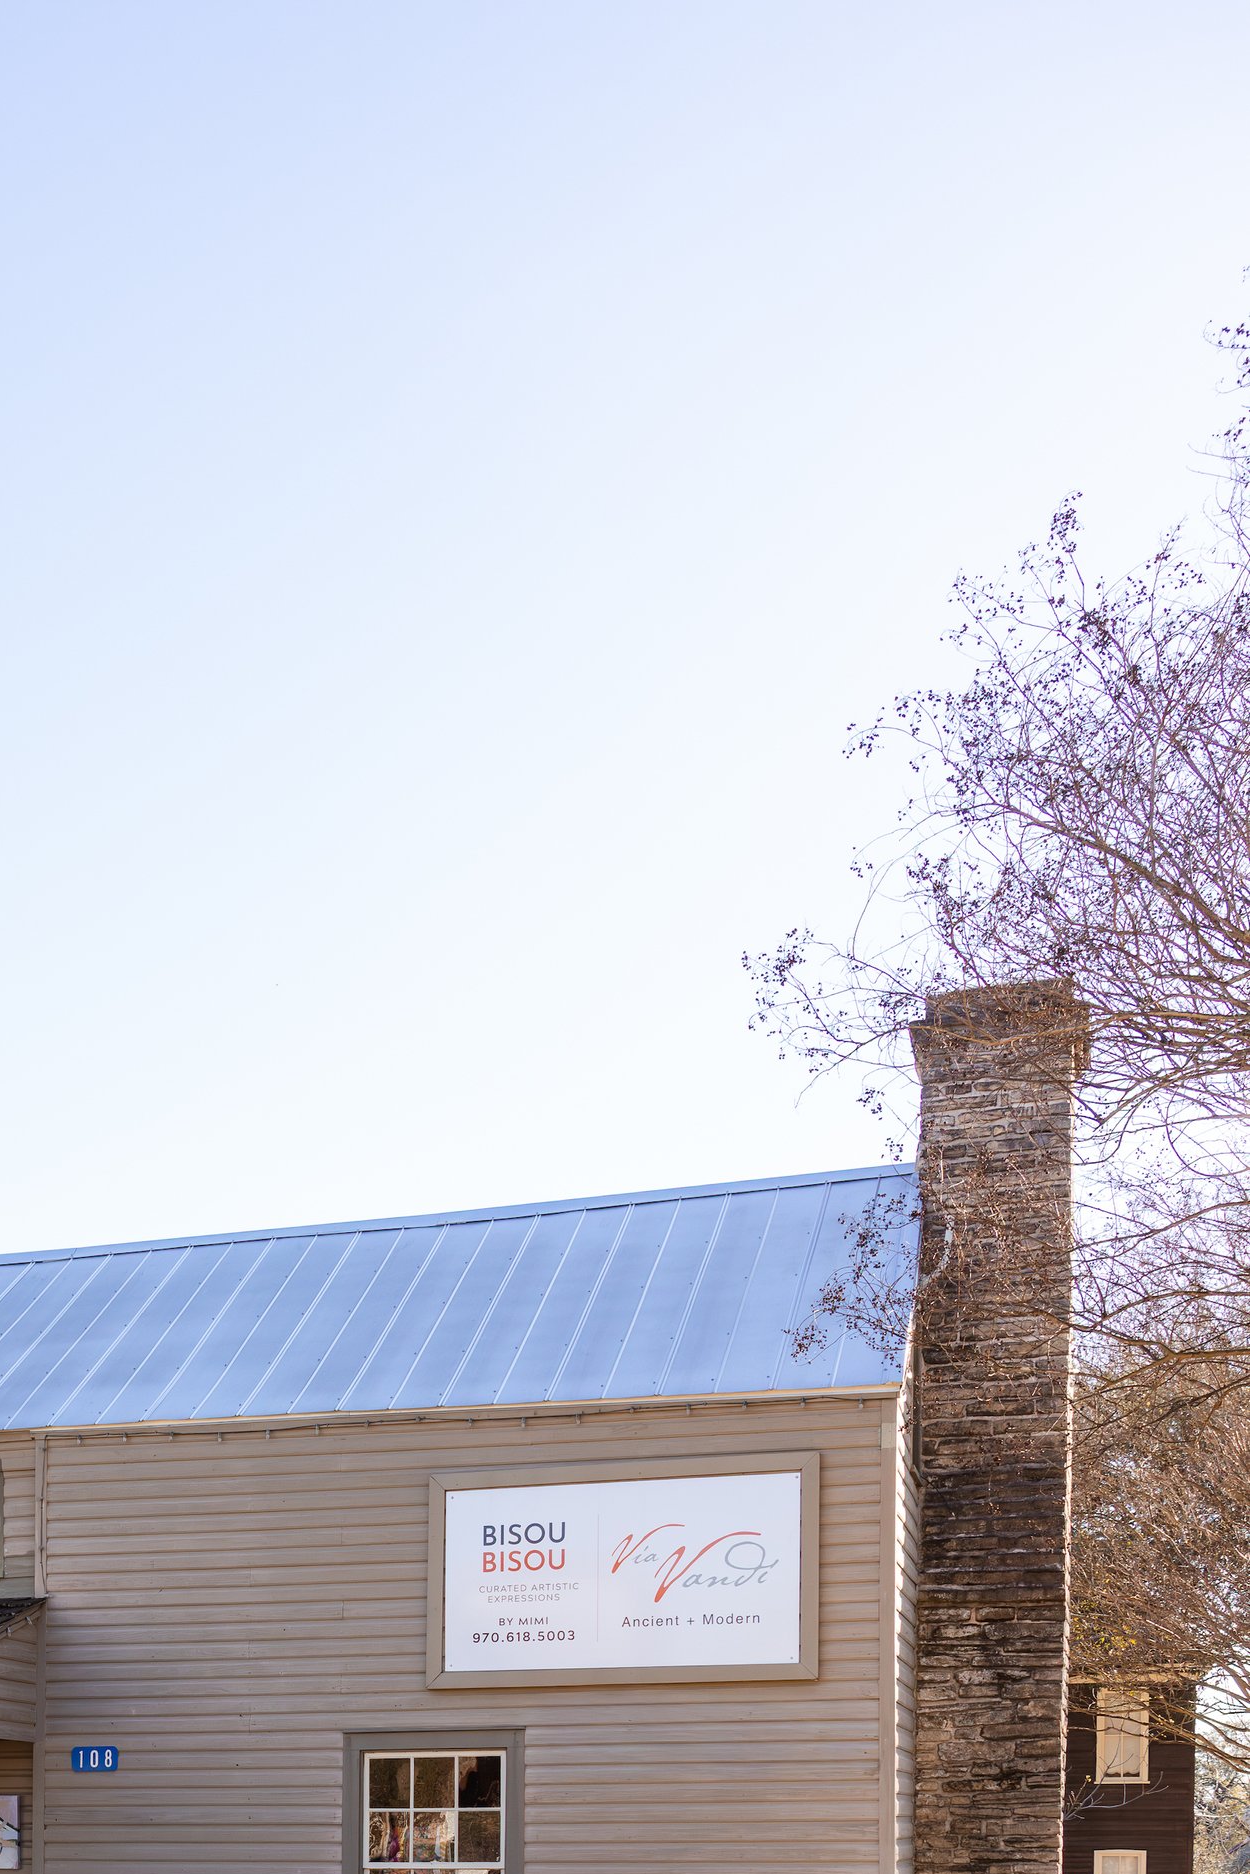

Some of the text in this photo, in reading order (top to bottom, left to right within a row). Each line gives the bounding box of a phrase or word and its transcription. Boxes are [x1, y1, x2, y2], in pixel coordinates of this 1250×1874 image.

[483, 1521, 566, 1546] BISOU
[482, 1548, 566, 1573] BISOU
[611, 1523, 779, 1603] Via Vandi
[478, 1582, 579, 1594] CURATED ARTISTIC
[487, 1593, 560, 1604] EXPRESSIONS
[498, 1616, 549, 1626] BY MIMI
[621, 1616, 680, 1628] Ancient
[702, 1613, 761, 1626] Modern
[472, 1630, 575, 1643] 970.618.5003
[79, 1749, 112, 1769] 108
